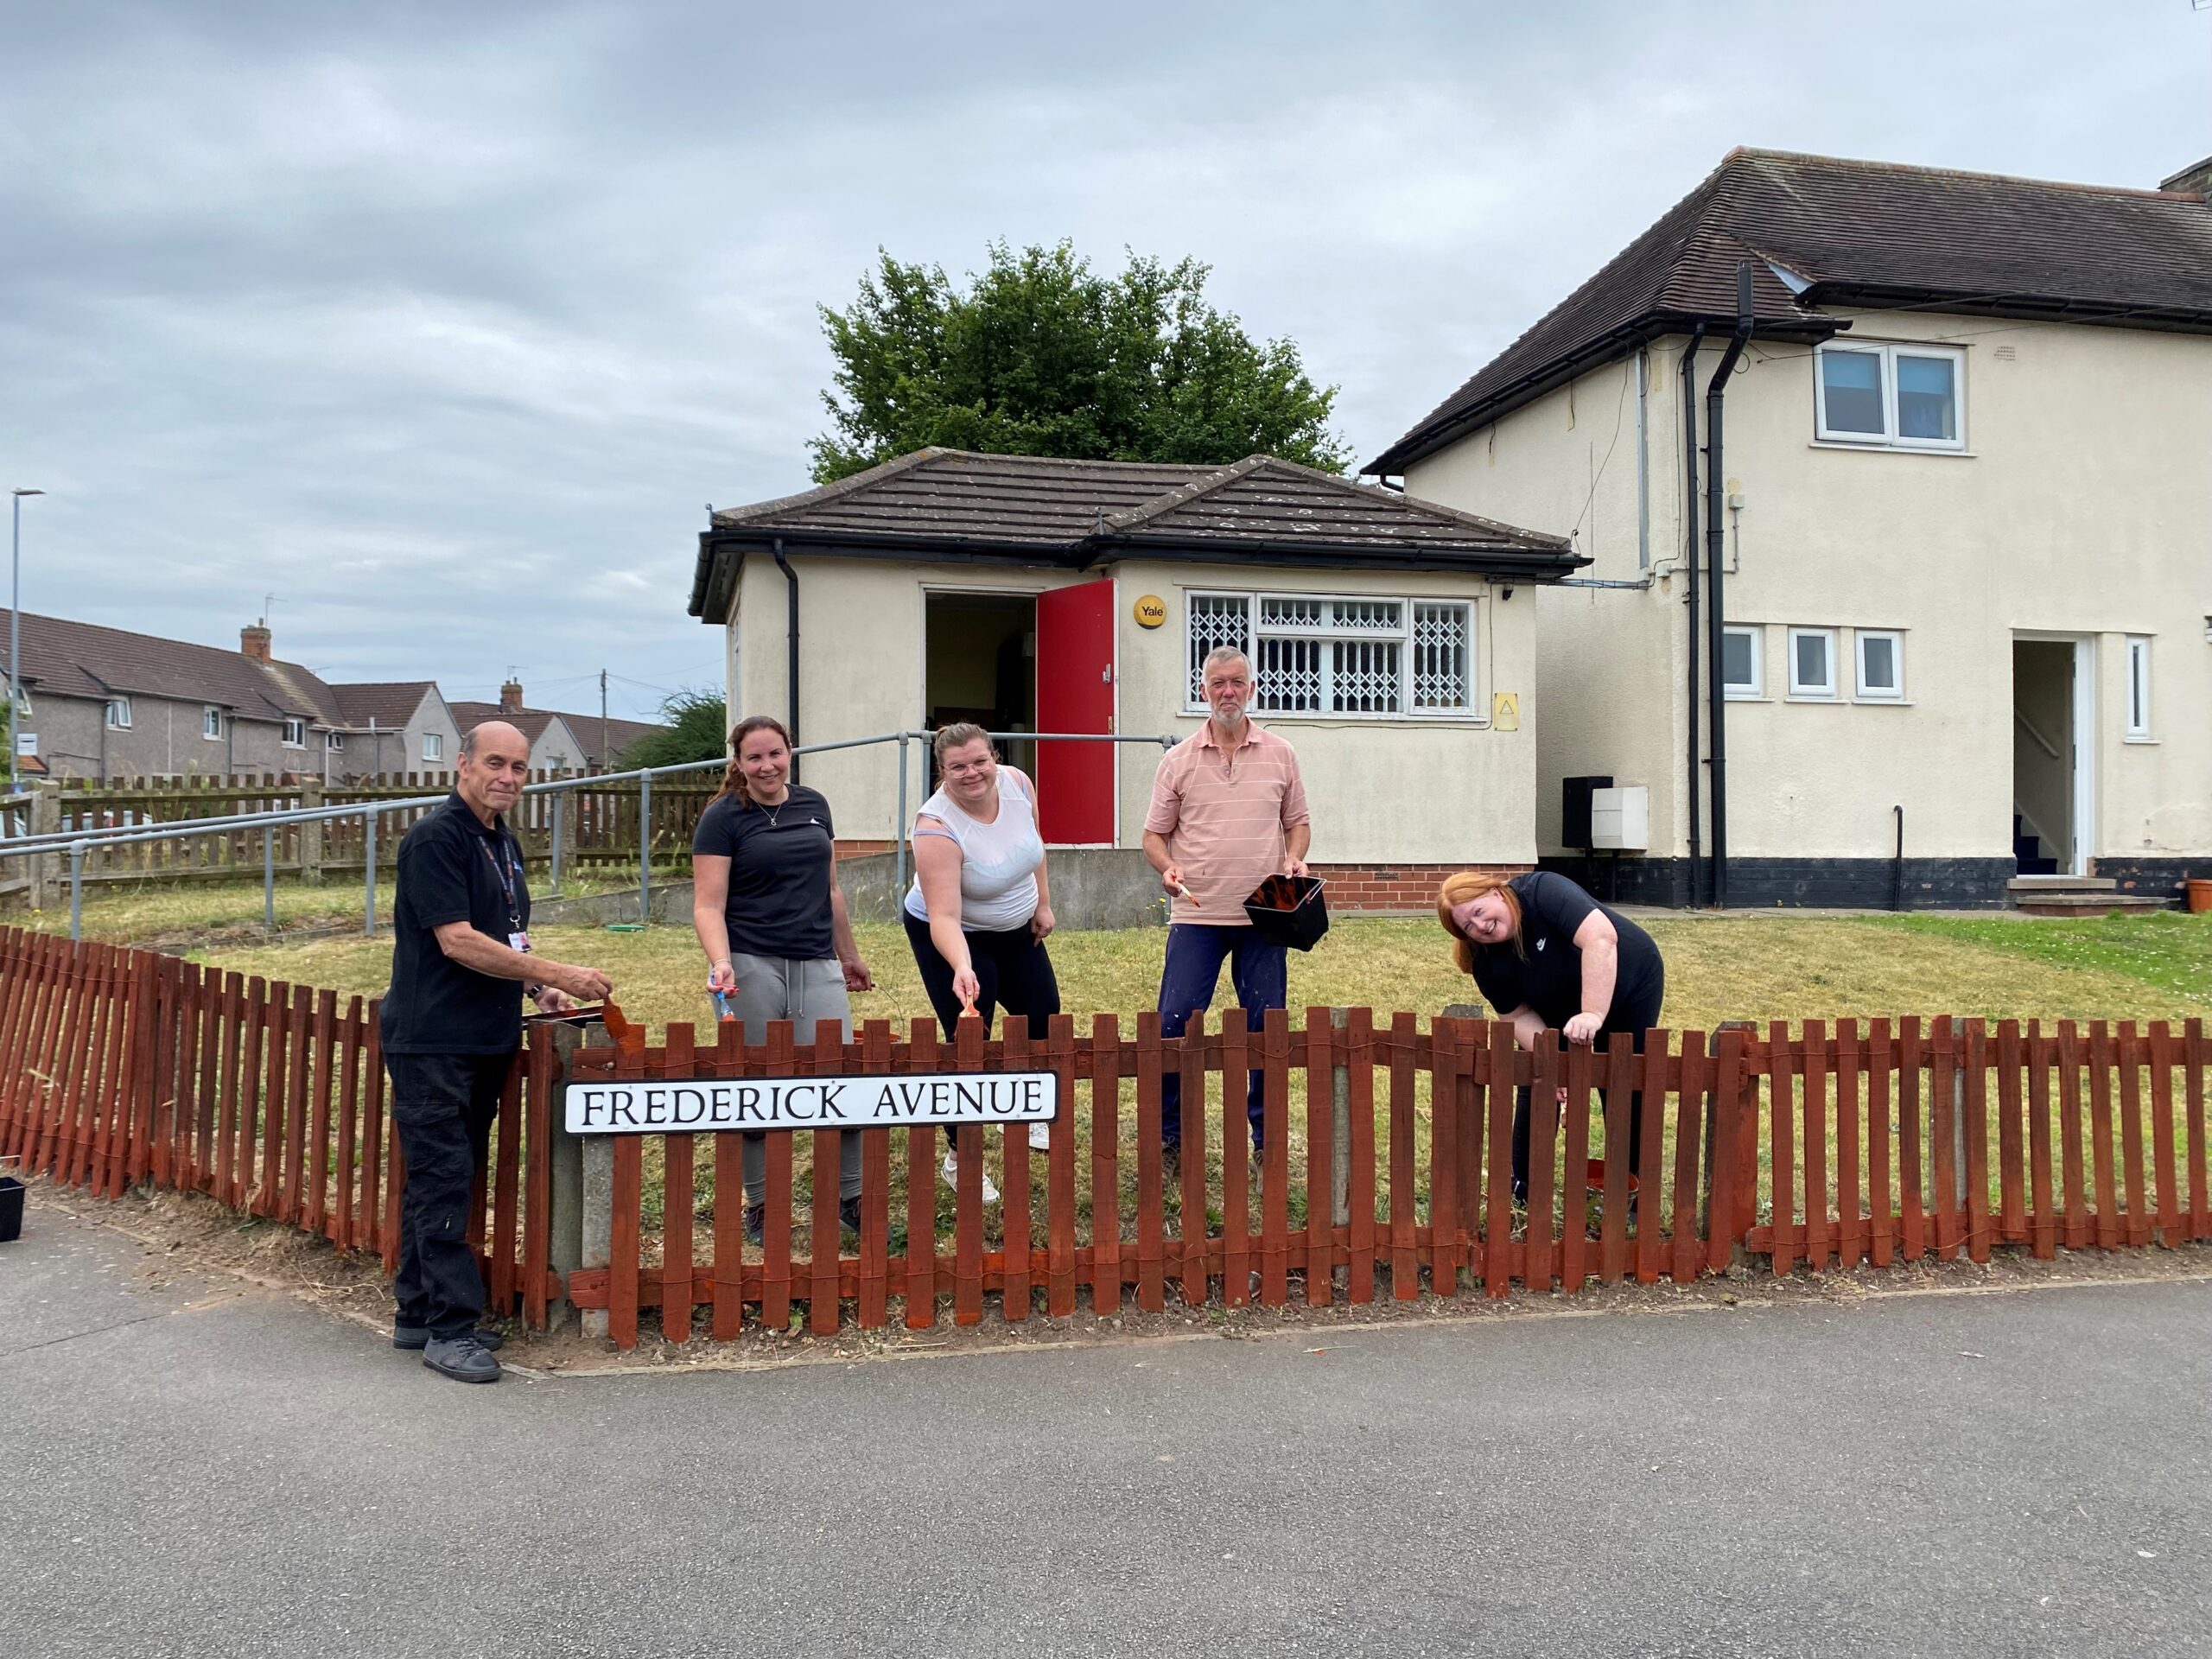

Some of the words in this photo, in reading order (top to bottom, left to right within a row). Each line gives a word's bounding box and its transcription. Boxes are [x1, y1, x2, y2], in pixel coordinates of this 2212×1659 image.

[1141, 606, 1164, 617] Yale
[582, 1084, 848, 1126] FREDERICK
[873, 1080, 1043, 1117] AVENUE
